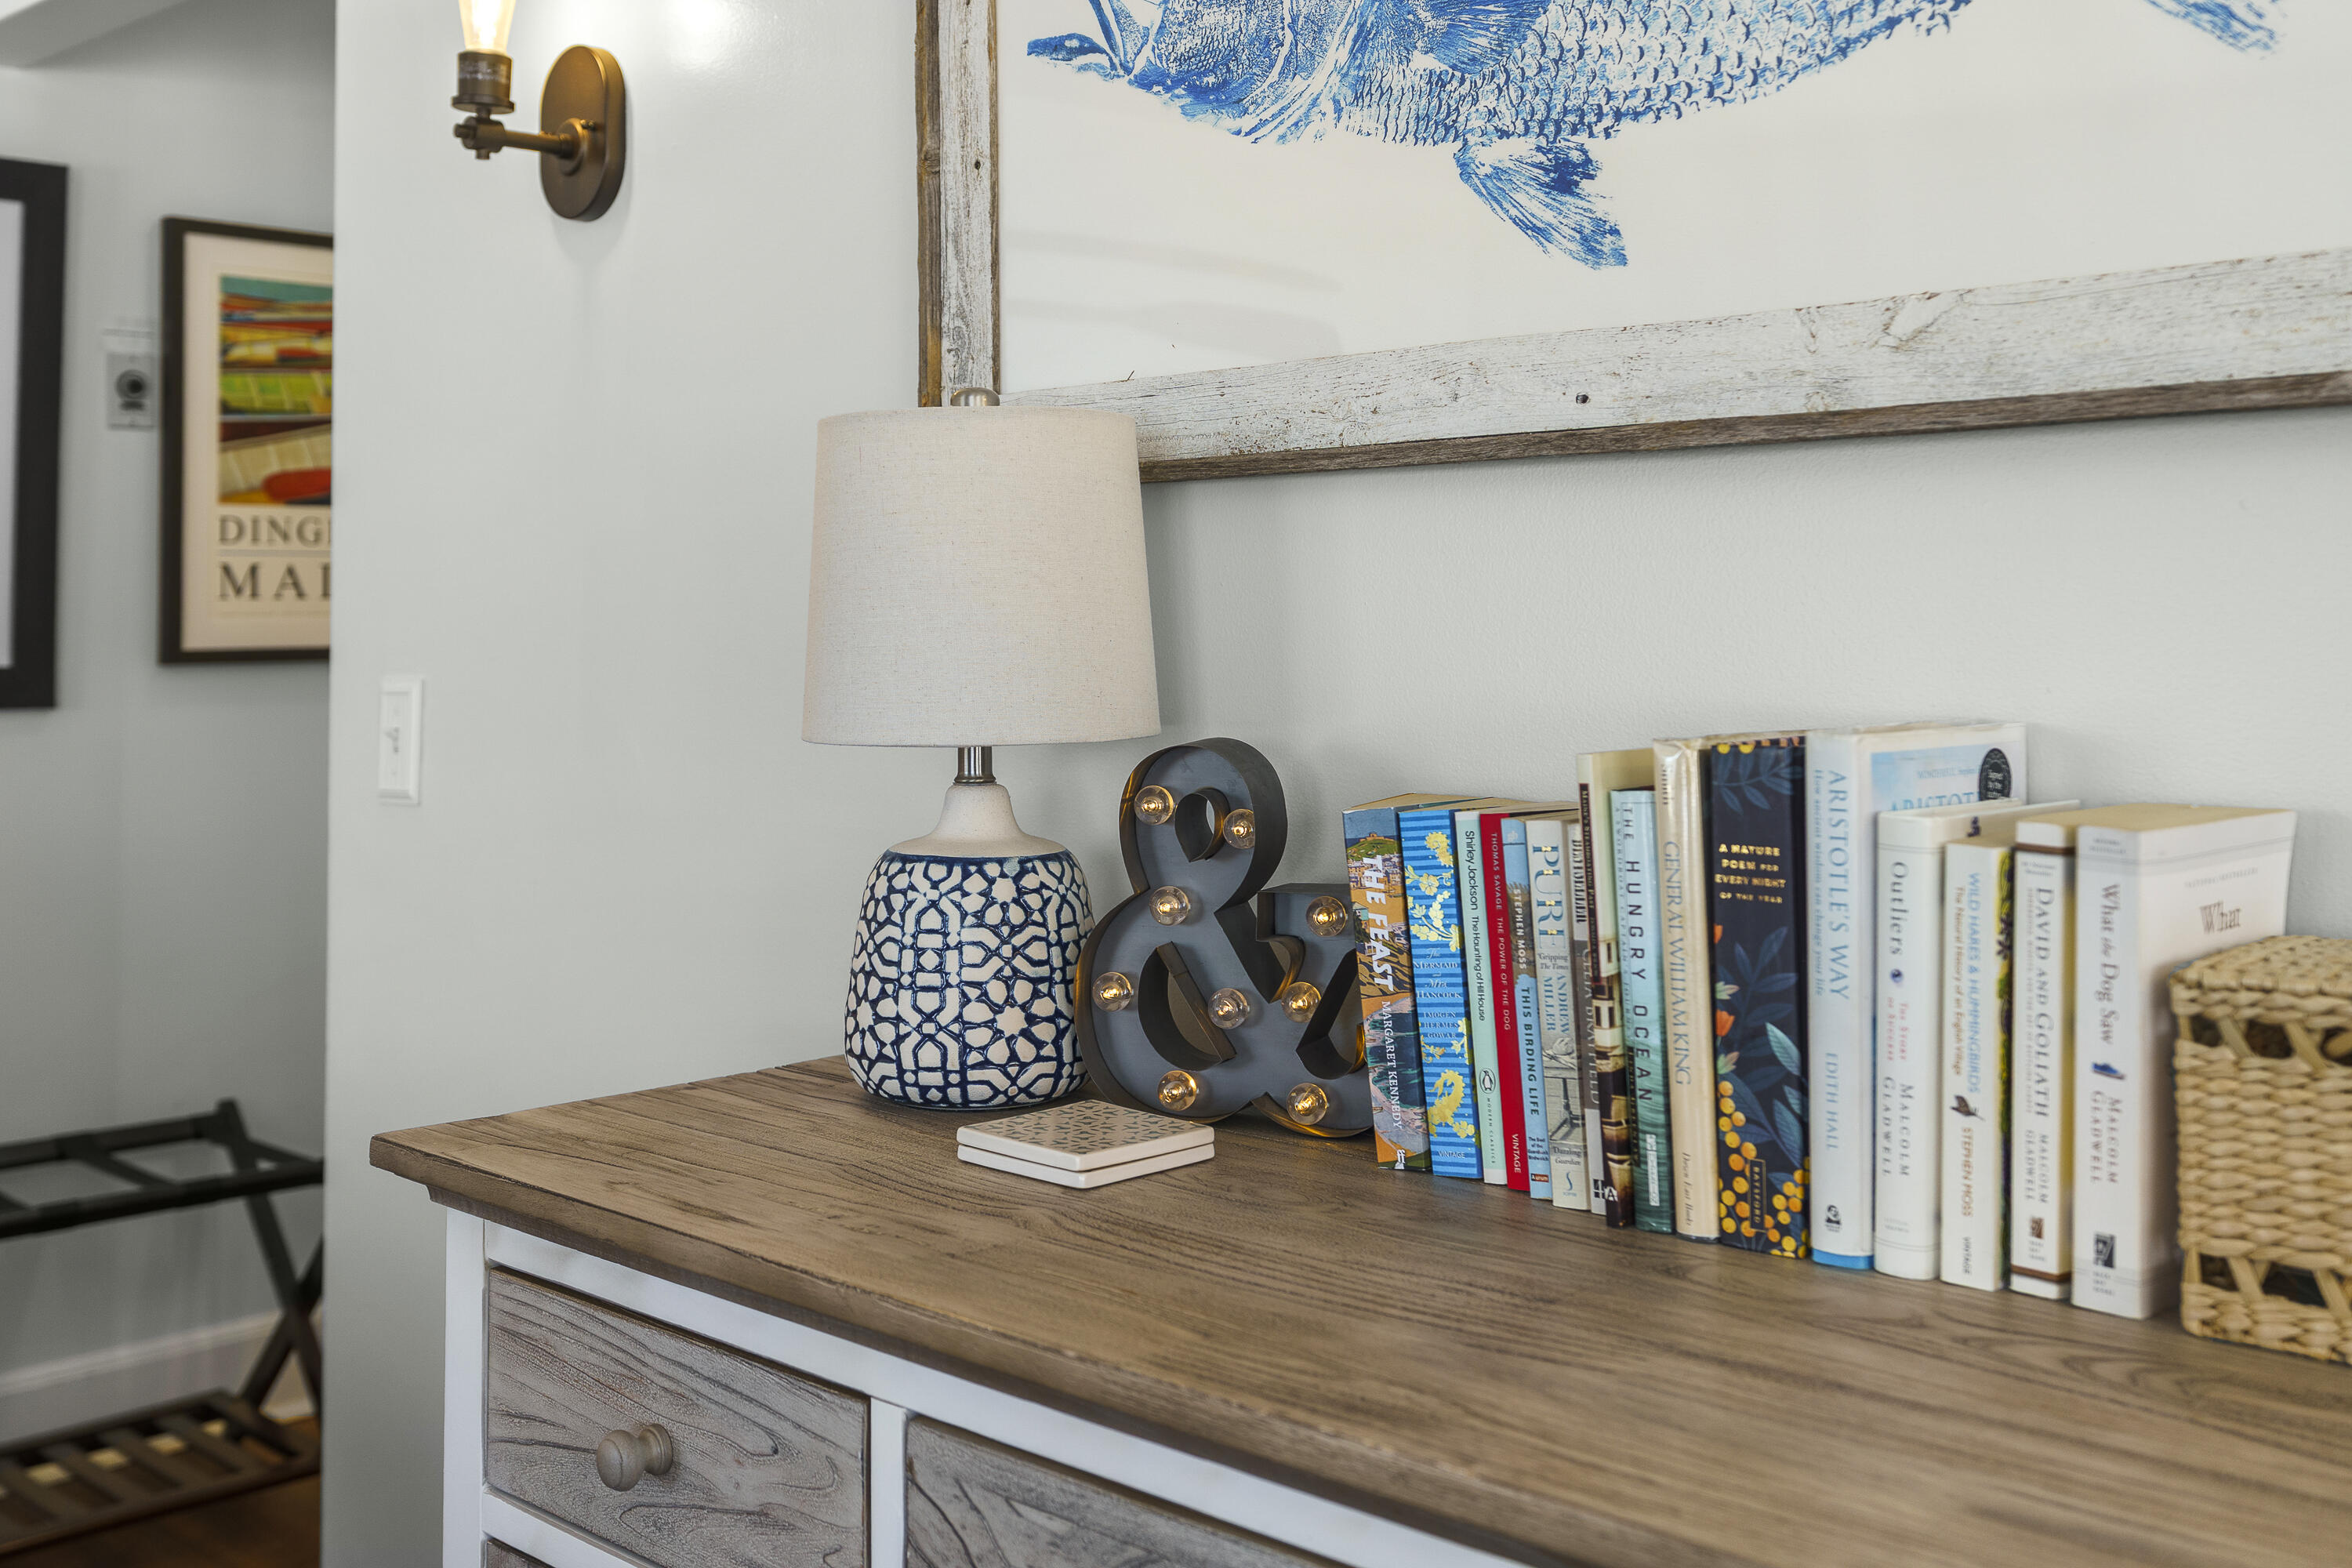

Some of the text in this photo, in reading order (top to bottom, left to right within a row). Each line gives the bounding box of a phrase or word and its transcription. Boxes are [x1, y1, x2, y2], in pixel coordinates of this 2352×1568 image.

[218, 514, 330, 547] DING
[1465, 830, 1475, 865] Shirley
[1491, 833, 1500, 871] THOMAS
[1719, 843, 1780, 857] A NATURE
[1721, 858, 1756, 870] POEM
[1468, 866, 1479, 910] Jackson
[1494, 875, 1503, 910] SAVAGE
[1532, 844, 1566, 949] PURE
[1715, 873, 1750, 885] EVERY
[1828, 770, 1850, 1000] ARISTOTLE'S WAY
[1967, 872, 1981, 911] WILD
[1363, 855, 1394, 992] THE FEAST
[1890, 862, 1909, 956] Outliers
[2034, 887, 2055, 961] DAVID
[2101, 884, 2120, 932] What
[1426, 947, 1441, 959] The
[1472, 932, 1483, 971] Haunting
[1624, 808, 1652, 1101] THE HUNGRY OCEAN
[1967, 914, 1981, 961] HARES
[1413, 961, 1458, 970] MERMAID
[1501, 973, 1508, 985] OF
[1663, 841, 1691, 1085] GENERAL WILLIAM KING
[2035, 967, 2049, 1006] AND
[2094, 963, 2120, 1003] Dog
[1503, 1009, 1512, 1031] DOG
[1513, 888, 1540, 1116] STEPHEN MOSS THIS BIRDING LIFE
[1542, 976, 1556, 1031] MILLER
[1556, 973, 1570, 1036] ANDREW
[1967, 978, 1981, 1094] HUMMINGBIRDS
[2100, 1007, 2120, 1046] Saw
[1381, 1001, 1403, 1130] MARGARET KENNEDY
[2034, 1012, 2055, 1117] GOLIATH
[1824, 1052, 1839, 1151] EDITH HALL
[1882, 1076, 1896, 1175] GLADWELL
[1899, 1083, 1915, 1176] MALCOLM
[2089, 1090, 2107, 1182] GLADWELL
[2107, 1096, 2122, 1183] MALCOLM
[1438, 1150, 1466, 1159] VINTAGE
[1512, 1134, 1522, 1174] VINTAGE
[1962, 1127, 1974, 1217] STEPHEN MOSS
